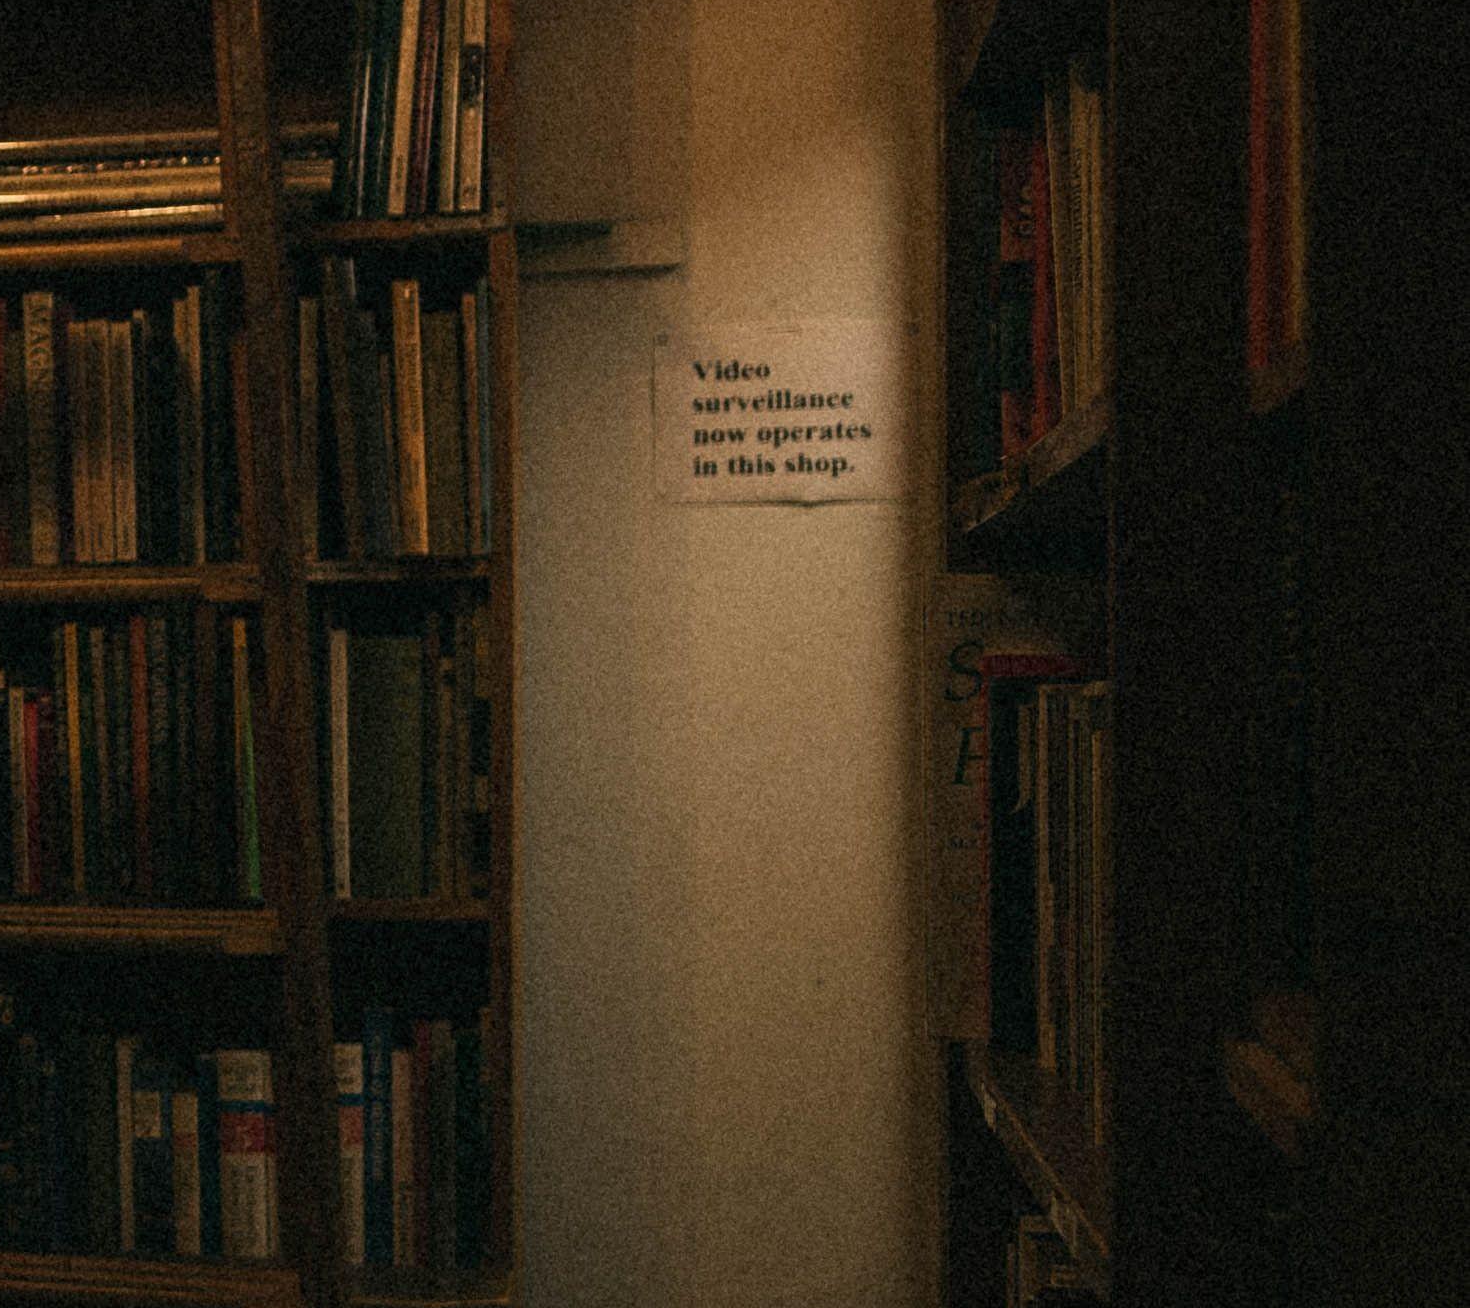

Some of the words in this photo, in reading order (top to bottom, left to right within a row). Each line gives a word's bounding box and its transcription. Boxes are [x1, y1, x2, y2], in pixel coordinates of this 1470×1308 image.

[691, 359, 772, 382] Video
[691, 389, 855, 414] surveillance
[693, 424, 748, 445] now
[756, 420, 873, 449] operates
[693, 455, 719, 477] in
[728, 454, 777, 476] this
[784, 452, 856, 478] shop.
